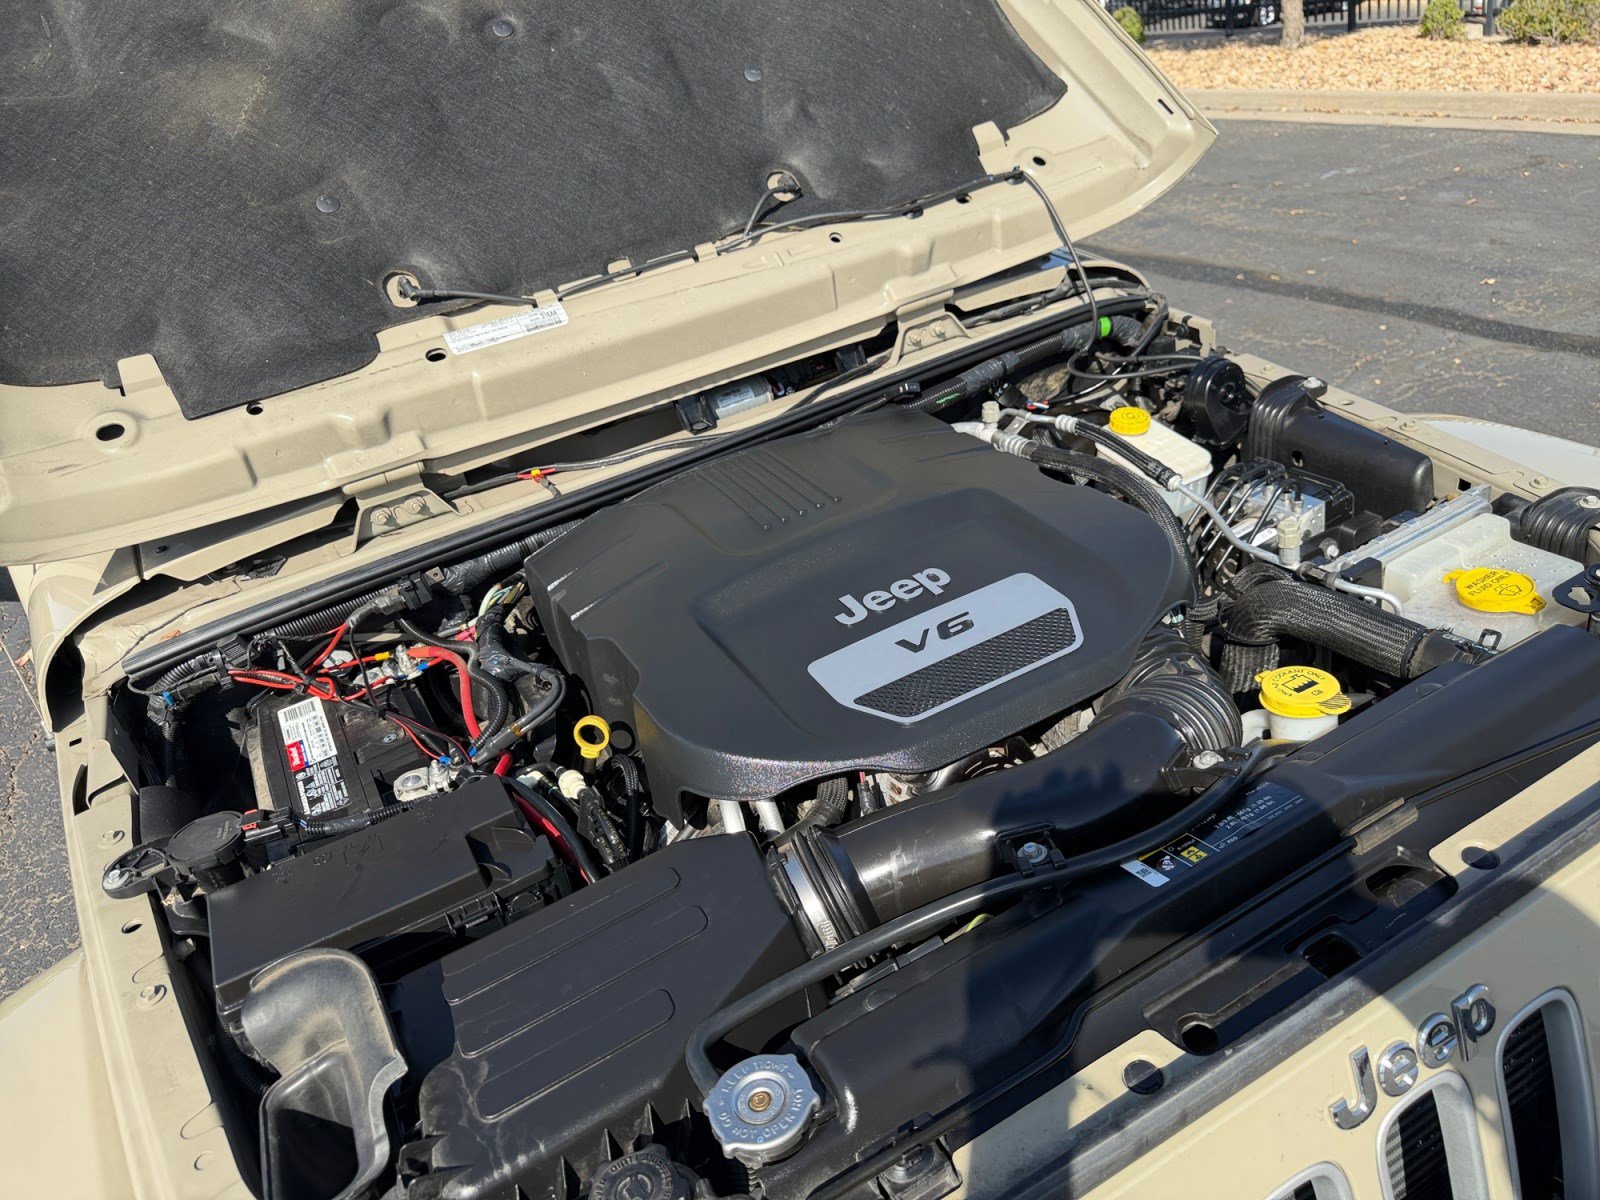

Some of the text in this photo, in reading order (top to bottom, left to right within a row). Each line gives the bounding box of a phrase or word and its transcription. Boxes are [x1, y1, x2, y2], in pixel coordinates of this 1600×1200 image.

[1464, 571, 1499, 590] WASHER
[1467, 571, 1512, 597] FLUID ONLY
[834, 567, 950, 625] Jeep
[894, 611, 975, 654] V6
[1272, 669, 1305, 683] COOLANT
[1306, 669, 1327, 681] ONLY
[1328, 983, 1496, 1130] Jeep
[731, 1126, 758, 1139] NOT
